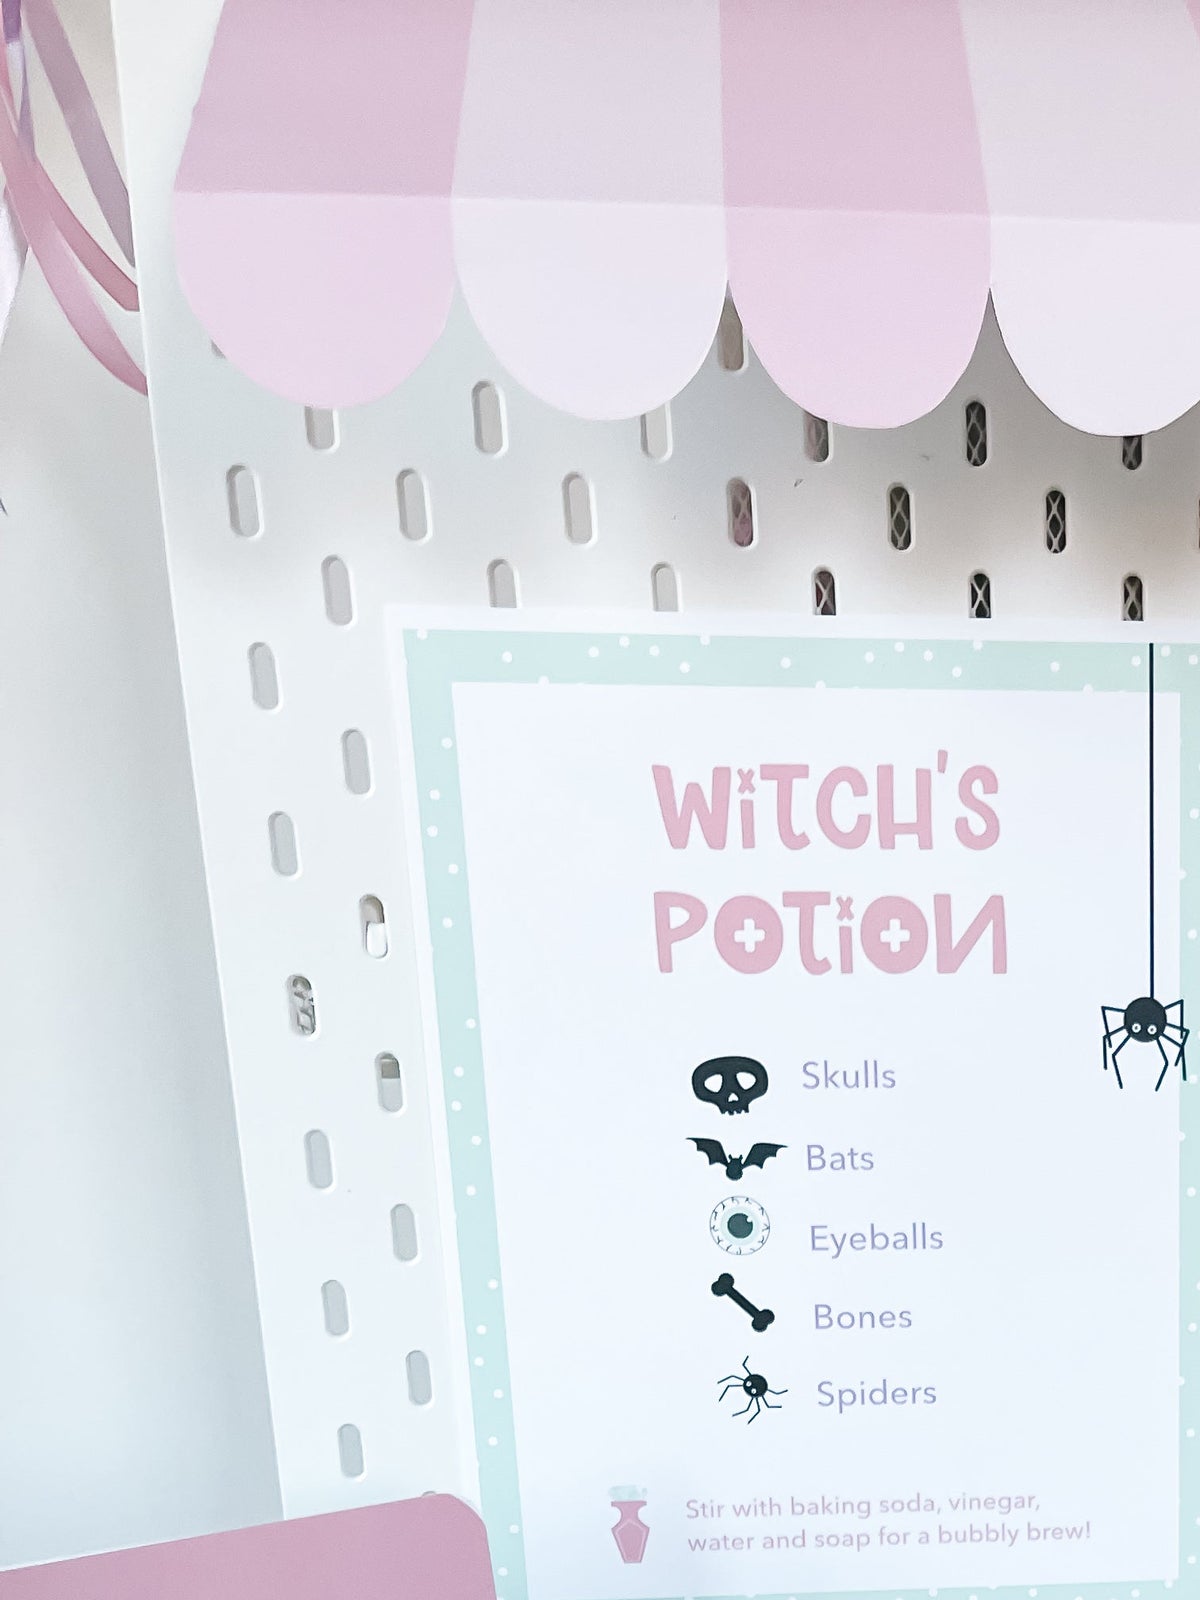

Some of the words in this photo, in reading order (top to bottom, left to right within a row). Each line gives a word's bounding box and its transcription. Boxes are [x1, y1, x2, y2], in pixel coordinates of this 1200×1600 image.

[801, 1059, 897, 1091] Skulls
[806, 1143, 875, 1173] Bats
[810, 1222, 944, 1260] Eyeballs
[813, 1303, 913, 1331] Bones
[817, 1379, 938, 1414] Spiders
[686, 1498, 726, 1520] Stir
[731, 1497, 782, 1518] with
[791, 1495, 872, 1520] baking
[879, 1492, 942, 1515] soda,
[948, 1492, 1041, 1516] vinegar,
[687, 1534, 755, 1552] water
[762, 1529, 807, 1550] and
[814, 1531, 871, 1553] soap
[878, 1526, 910, 1546] for
[917, 1530, 931, 1545] a
[938, 1522, 1020, 1548] bubbly
[1027, 1521, 1091, 1542] brew!
